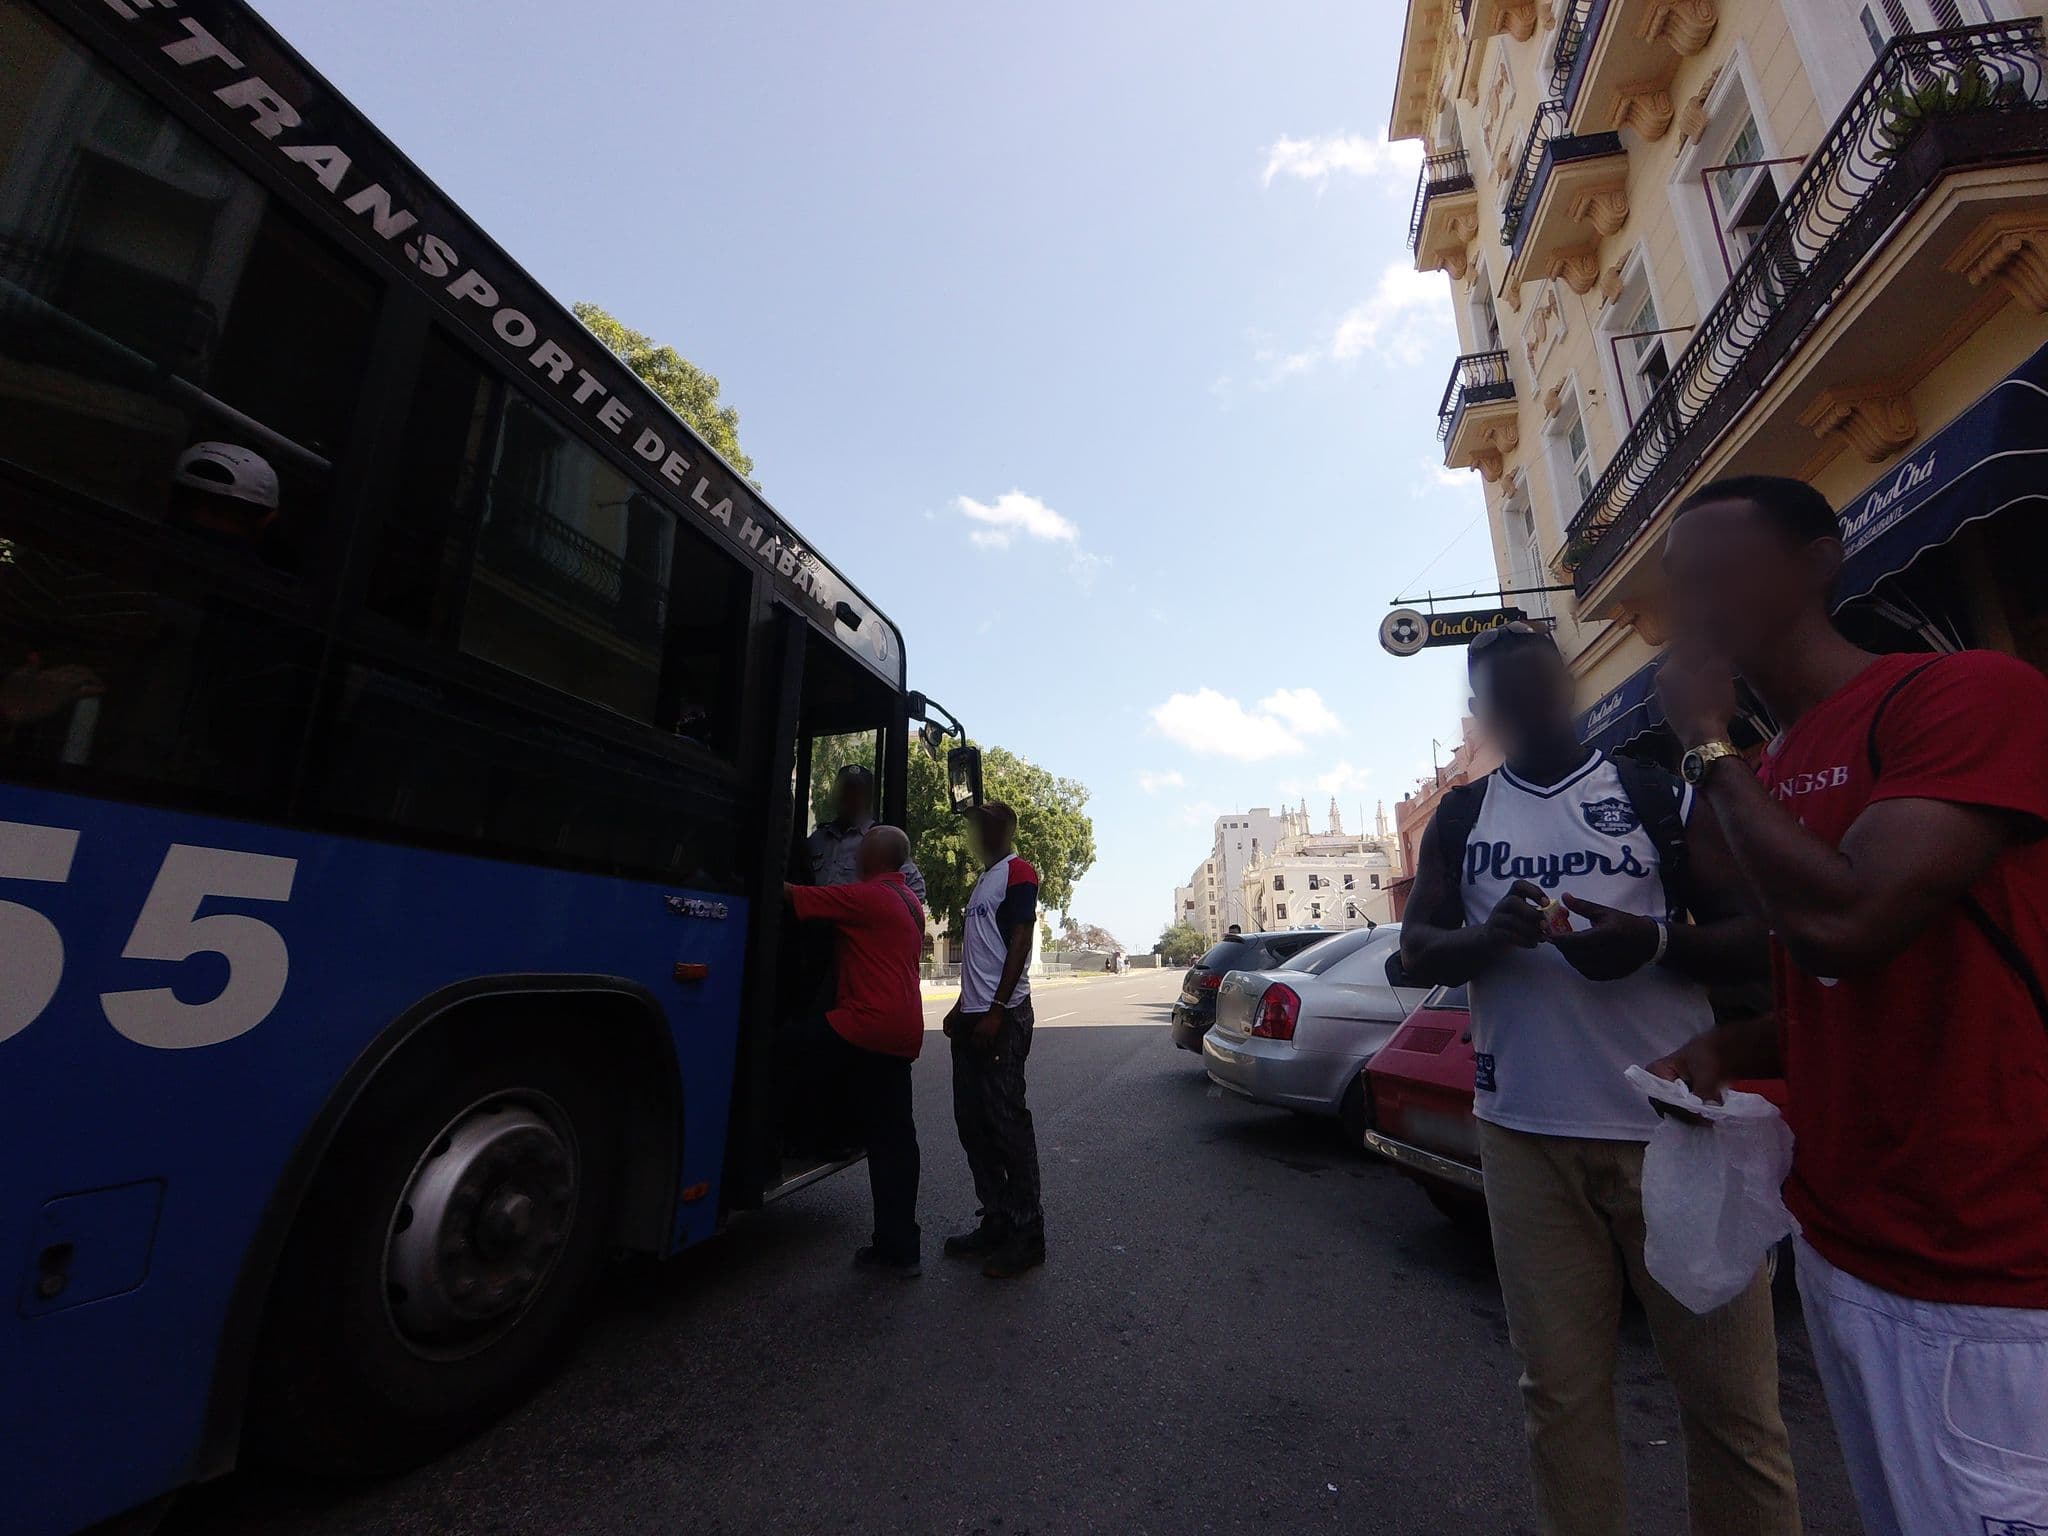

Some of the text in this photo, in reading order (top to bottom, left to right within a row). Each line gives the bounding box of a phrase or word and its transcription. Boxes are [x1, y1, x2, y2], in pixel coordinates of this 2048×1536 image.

[633, 427, 691, 487] DE
[691, 477, 734, 528] LA
[1769, 765, 1849, 801] NGSB
[1467, 841, 1650, 888] Players
